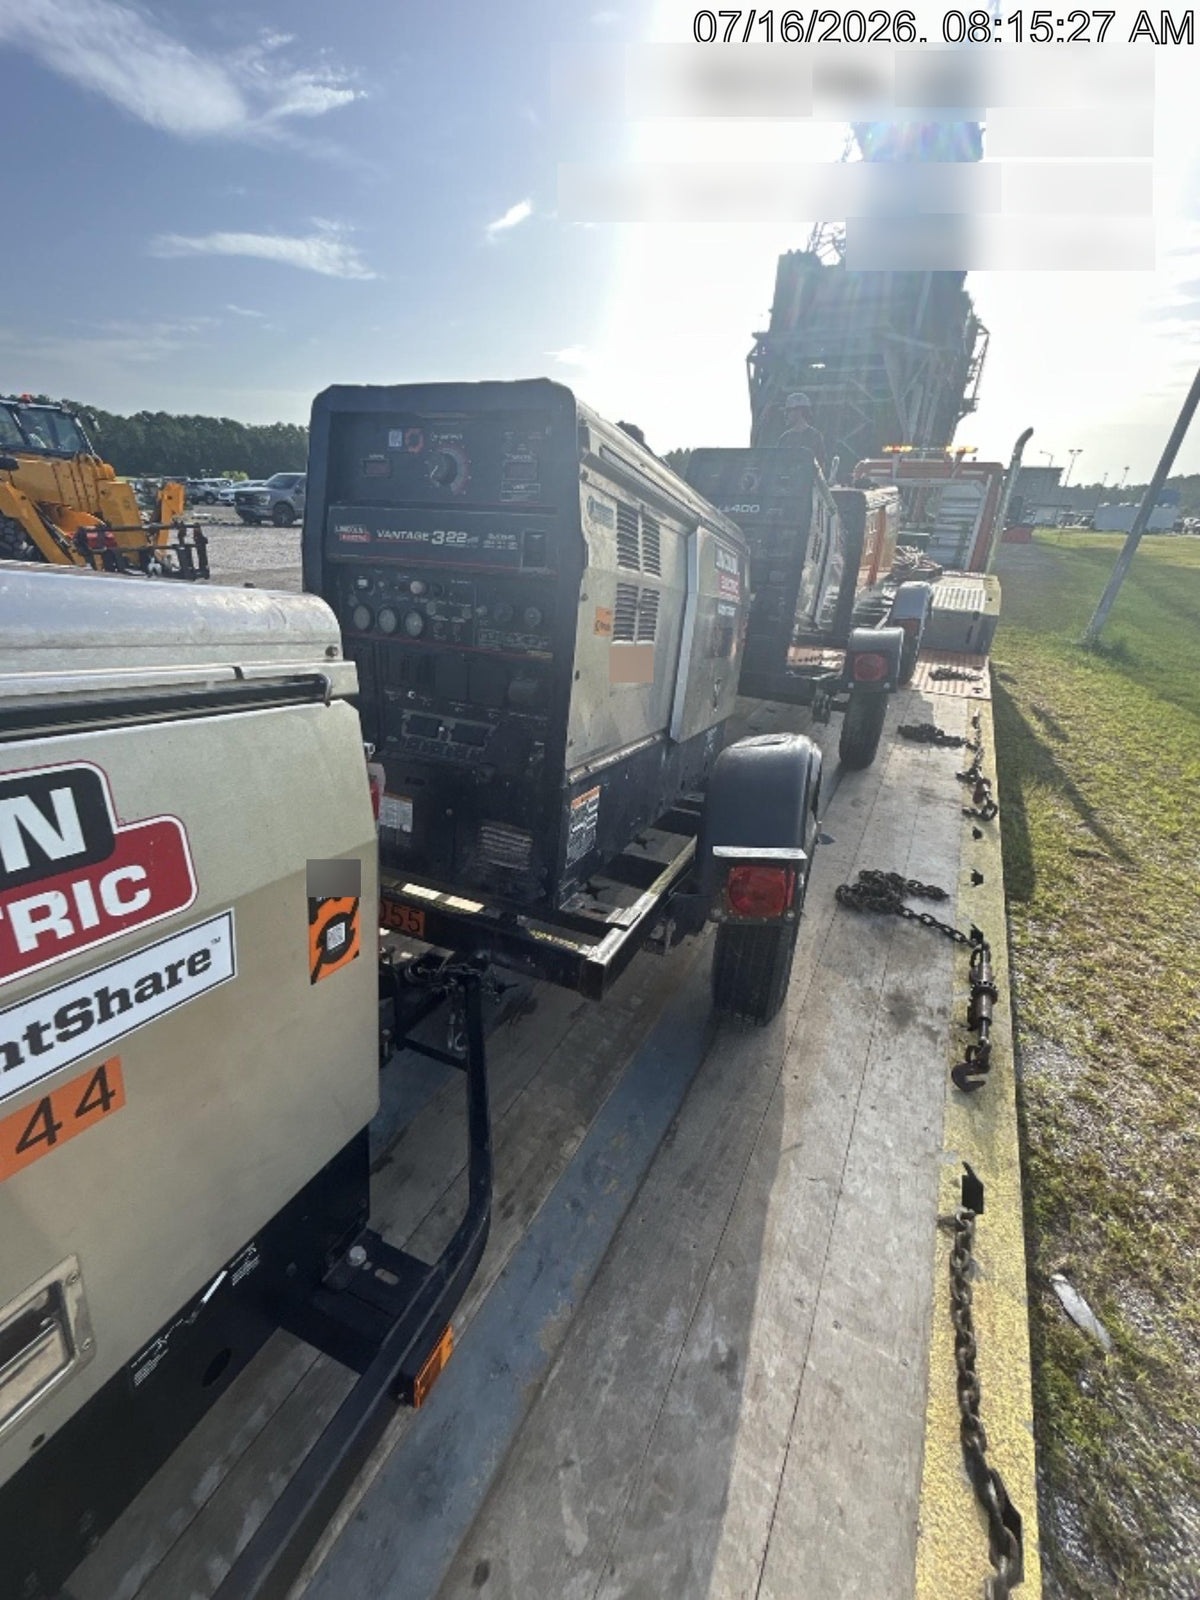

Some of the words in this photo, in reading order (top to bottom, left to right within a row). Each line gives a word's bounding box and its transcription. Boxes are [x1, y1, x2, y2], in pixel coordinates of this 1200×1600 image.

[376, 529, 430, 541] VANTAGE
[432, 530, 468, 545] 322
[0, 864, 152, 953] RIC
